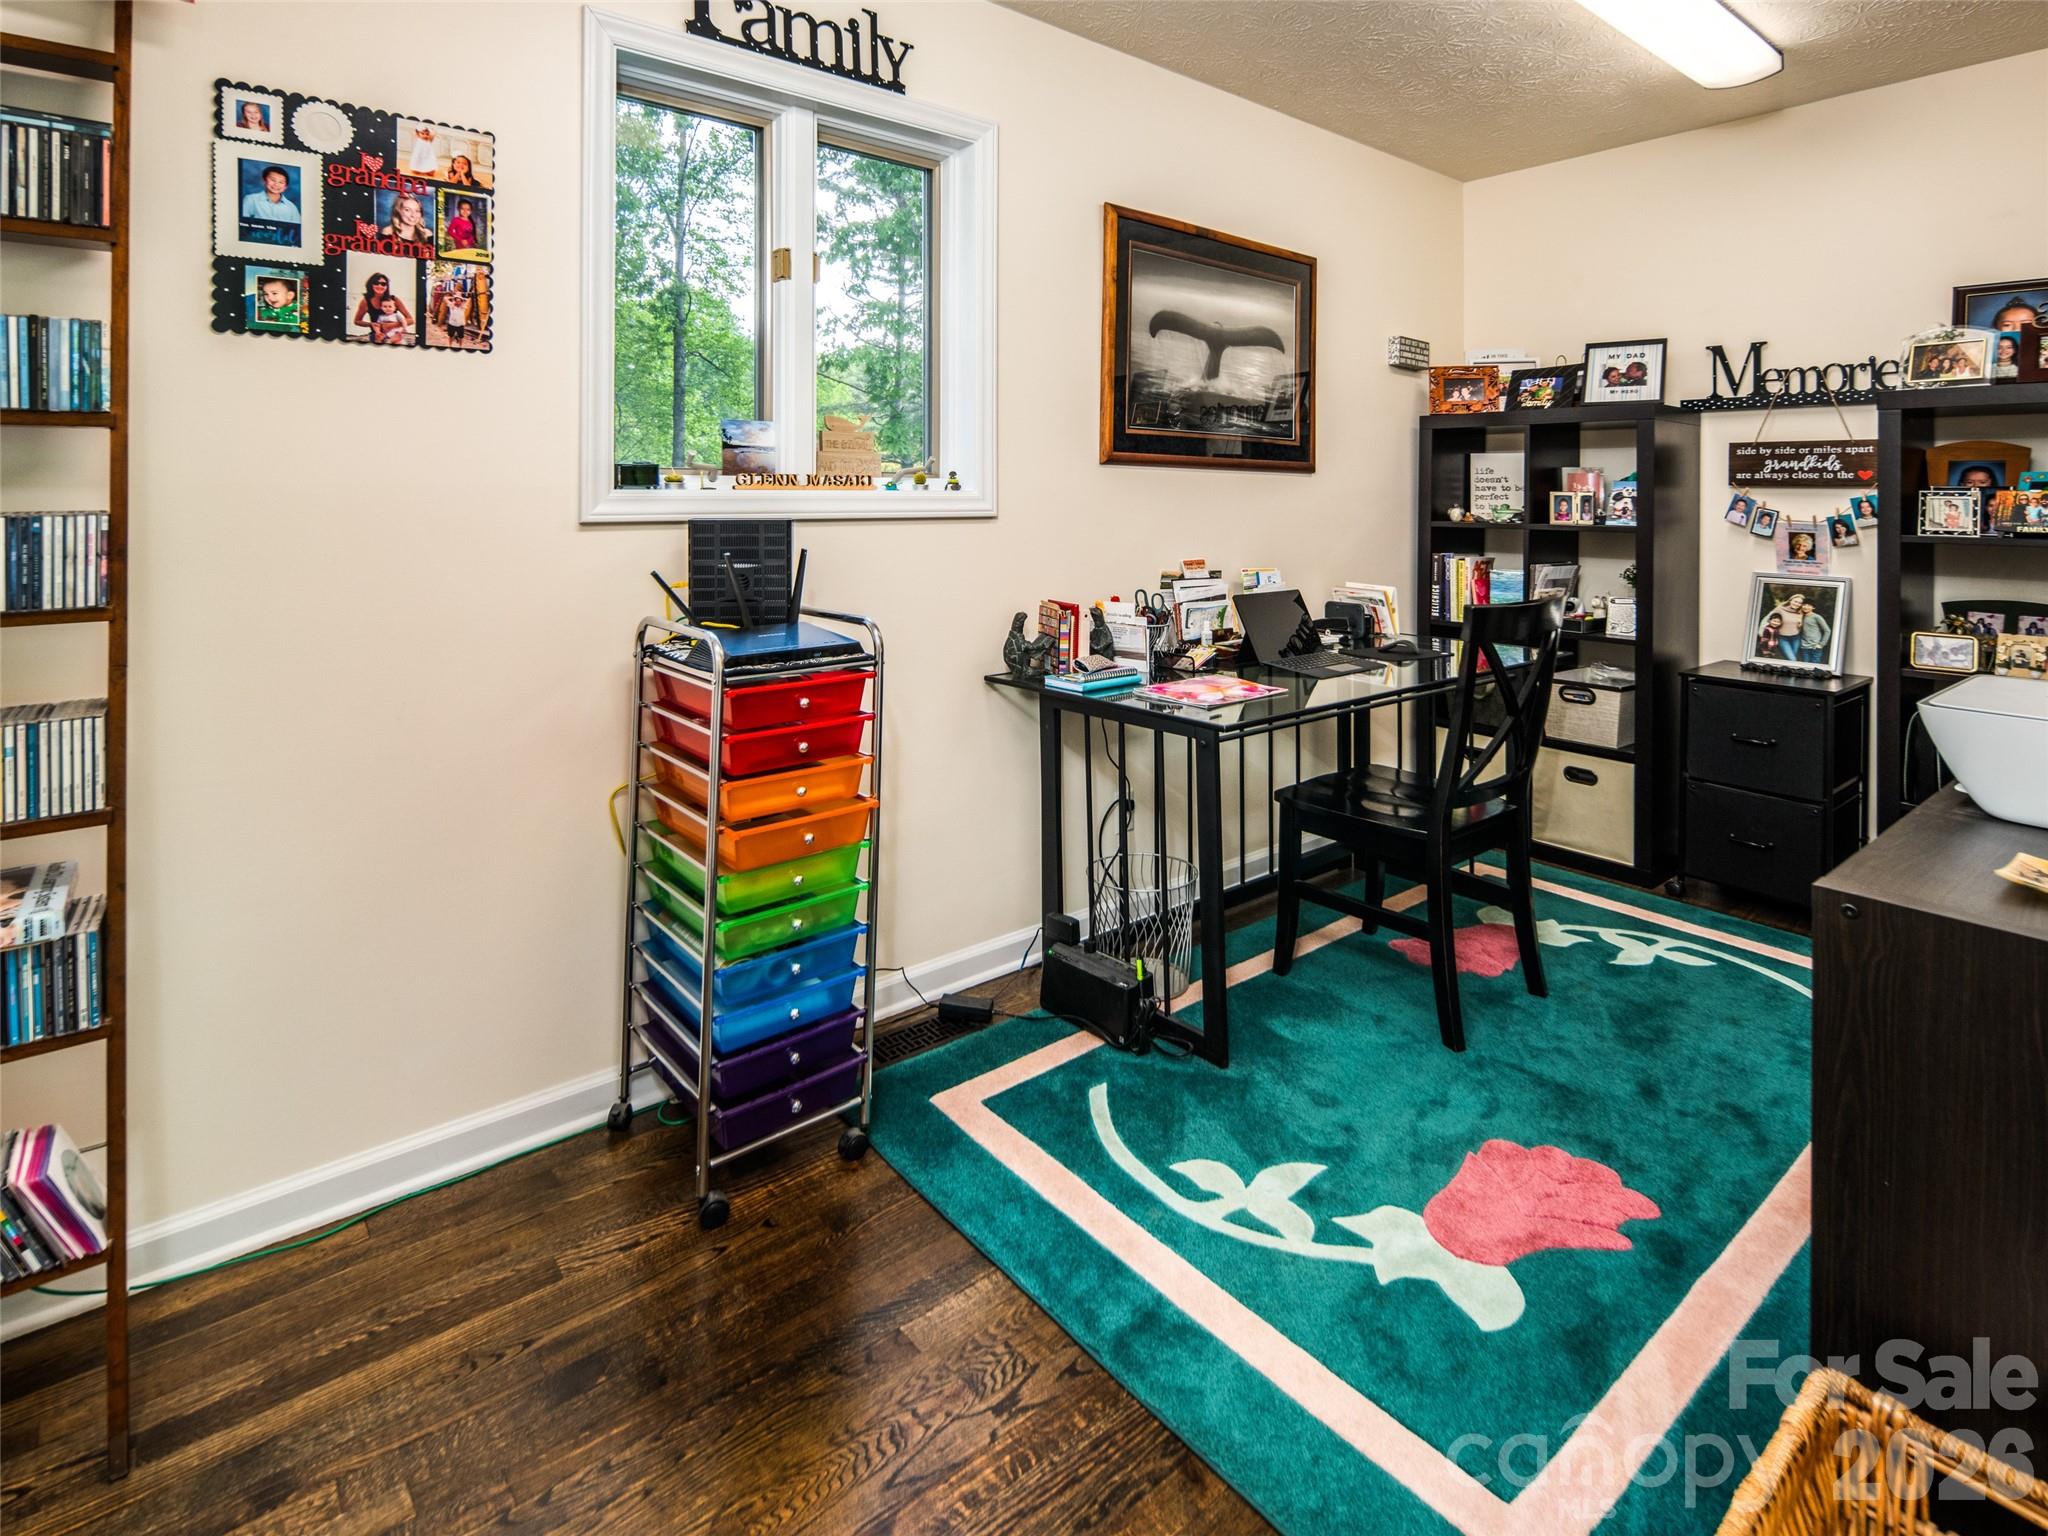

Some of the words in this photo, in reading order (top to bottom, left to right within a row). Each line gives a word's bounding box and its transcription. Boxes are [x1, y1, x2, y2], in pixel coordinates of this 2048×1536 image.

[326, 163, 429, 197] grandpa
[323, 233, 437, 260] grandma
[1735, 447, 1757, 455] side
[1759, 447, 1772, 456] by
[1774, 446, 1792, 455] side
[1813, 446, 1842, 454] miles
[1845, 445, 1874, 455] apart
[1474, 467, 1495, 475] life
[1763, 455, 1843, 473] grandkids
[735, 472, 800, 487] GLENN
[805, 473, 873, 487] MASAKI
[1754, 471, 1789, 481] always
[1792, 471, 1820, 479] close
[1837, 471, 1855, 479] the
[1474, 493, 1509, 502] perfect
[1431, 584, 1440, 617] BELICHICK
